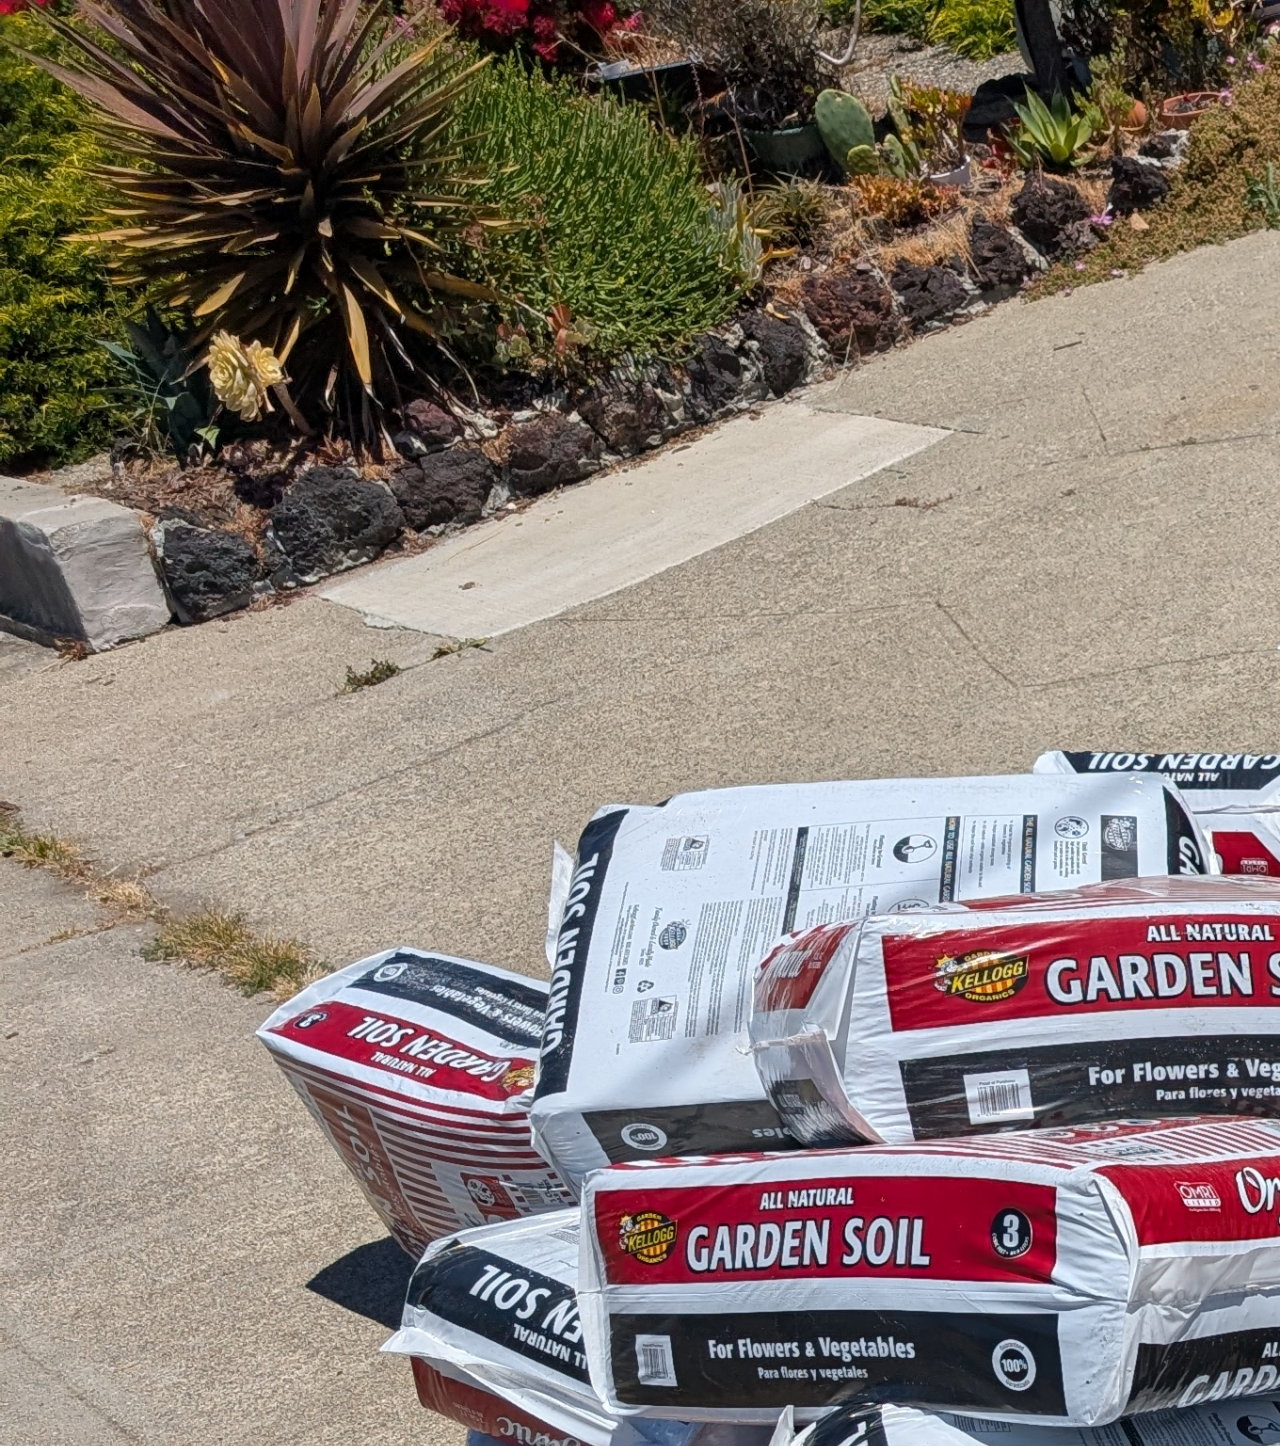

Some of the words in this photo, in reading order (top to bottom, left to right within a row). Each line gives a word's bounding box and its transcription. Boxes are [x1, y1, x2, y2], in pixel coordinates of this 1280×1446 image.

[1087, 752, 1155, 771] SOIL
[1147, 924, 1181, 941] ALL
[1185, 924, 1274, 941] NATURAL
[542, 925, 581, 1057] GARDEN
[563, 851, 599, 923] SOIL
[951, 960, 1024, 992] KELLOGG
[1046, 952, 1253, 1004] GARDEN
[347, 1016, 414, 1047] SOIL
[370, 1051, 414, 1074] NATURAL
[401, 1035, 513, 1082] GARDEN
[415, 1063, 437, 1079] ALL
[1088, 1065, 1126, 1086] For
[1132, 1062, 1219, 1083] Flowers
[1226, 1063, 1240, 1078] &
[1156, 1088, 1185, 1101] Para
[1188, 1086, 1226, 1099] flores
[1229, 1088, 1238, 1100] y
[760, 1191, 783, 1210] ALL
[788, 1187, 854, 1208] NATURAL
[627, 1226, 675, 1252] KELLOGG
[687, 1219, 830, 1271] GARDEN
[842, 1217, 930, 1266] SOIL
[1003, 1214, 1019, 1248] 3
[468, 1264, 551, 1320] SOIL
[708, 1339, 733, 1359] For
[737, 1338, 800, 1359] Flowers
[805, 1341, 816, 1357] &
[818, 1336, 915, 1362] Vegetables
[758, 1367, 779, 1380] Para
[781, 1366, 809, 1381] flores
[810, 1368, 817, 1381] y
[819, 1365, 868, 1381] vegetales
[1001, 1358, 1028, 1373] 100%
